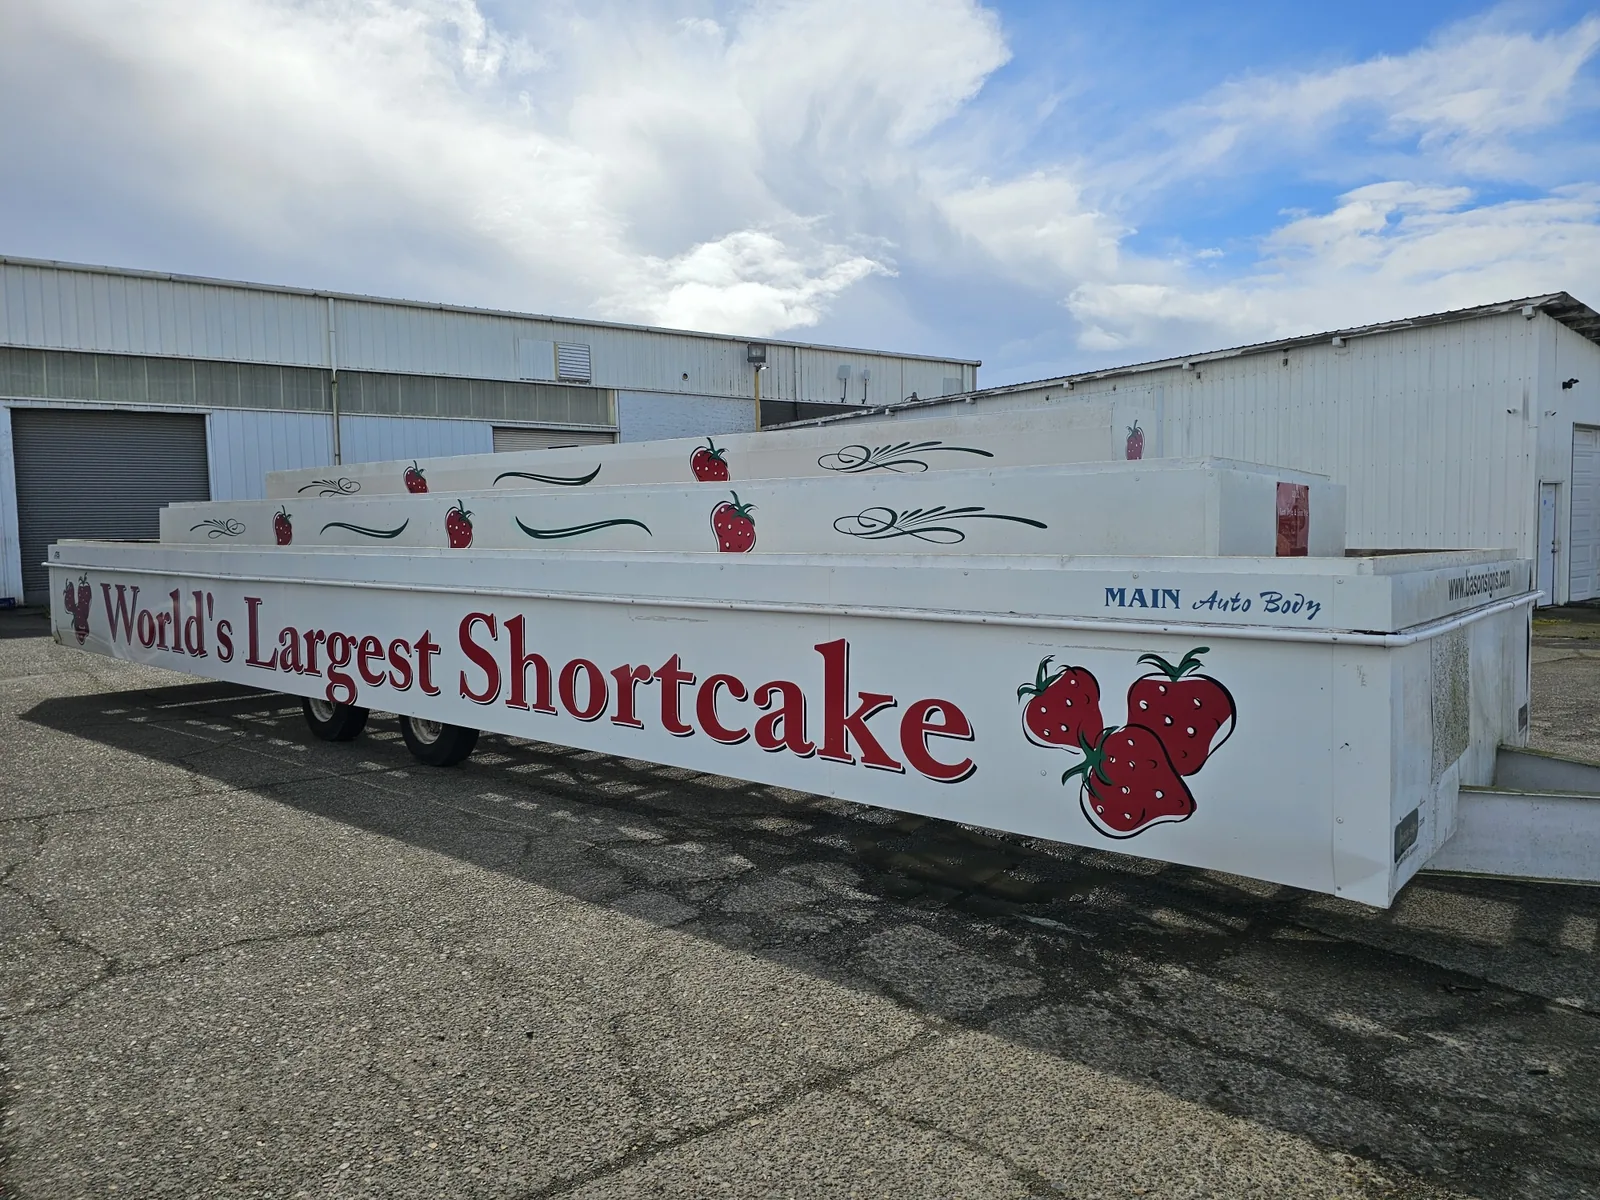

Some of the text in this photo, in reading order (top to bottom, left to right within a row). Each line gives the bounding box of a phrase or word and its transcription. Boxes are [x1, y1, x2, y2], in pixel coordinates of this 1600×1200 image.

[1105, 587, 1321, 620] MAIN Auto Body
[100, 582, 977, 784] World's Largest Shortcake
